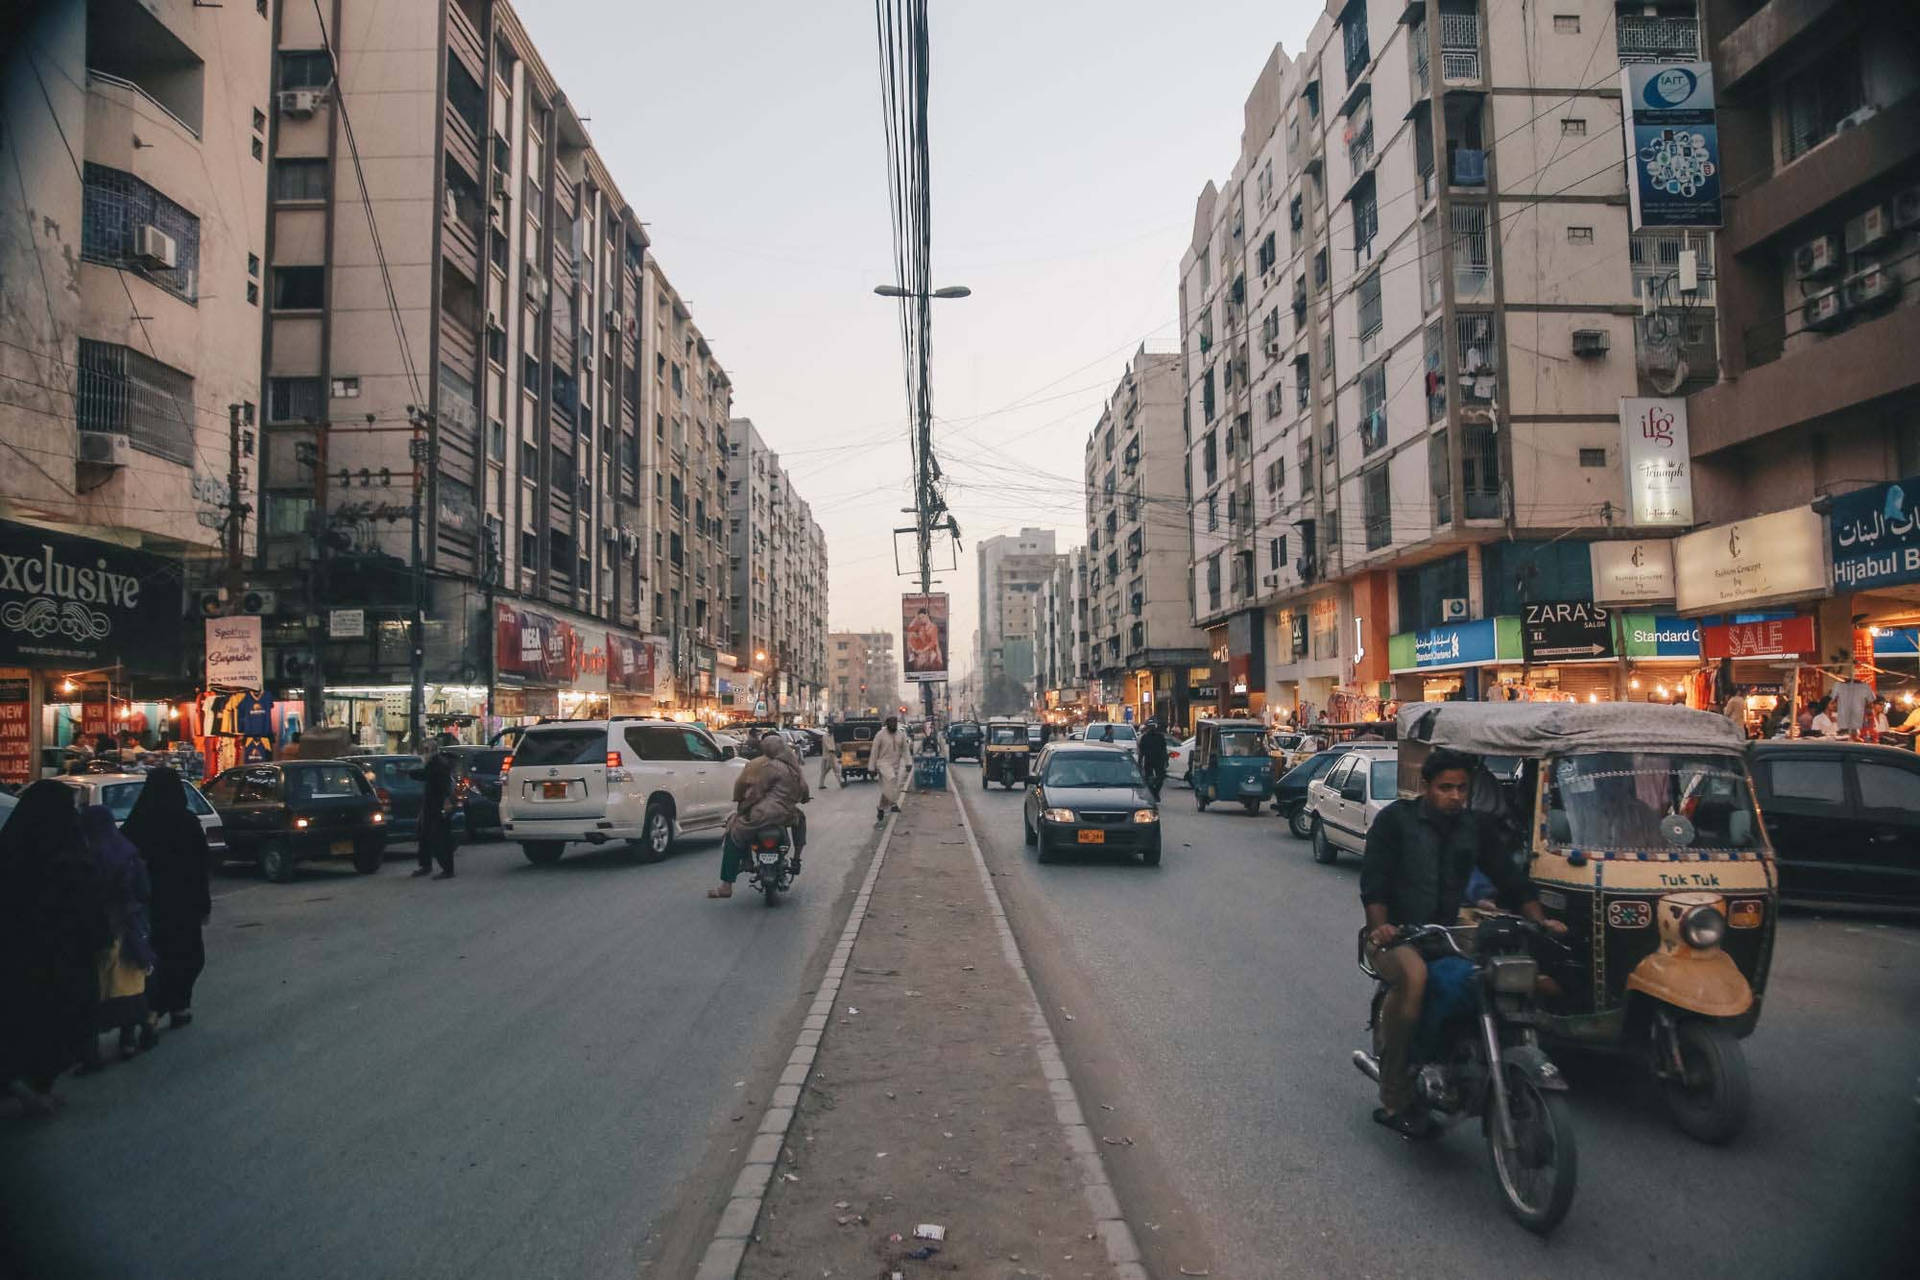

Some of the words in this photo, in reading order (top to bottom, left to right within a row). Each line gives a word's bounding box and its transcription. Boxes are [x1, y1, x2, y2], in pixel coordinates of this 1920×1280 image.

[1640, 461, 1684, 482] Triumph
[1839, 509, 1886, 547] البنات
[0, 544, 140, 608] xclusive
[1834, 552, 1897, 586] Hijabul
[1527, 603, 1607, 624] ZARA'S
[1584, 621, 1606, 629] SALON
[1634, 628, 1690, 643] Standard
[1728, 621, 1783, 656] SALE
[1659, 874, 1689, 886] Tuk
[1691, 873, 1720, 887] Tuk
